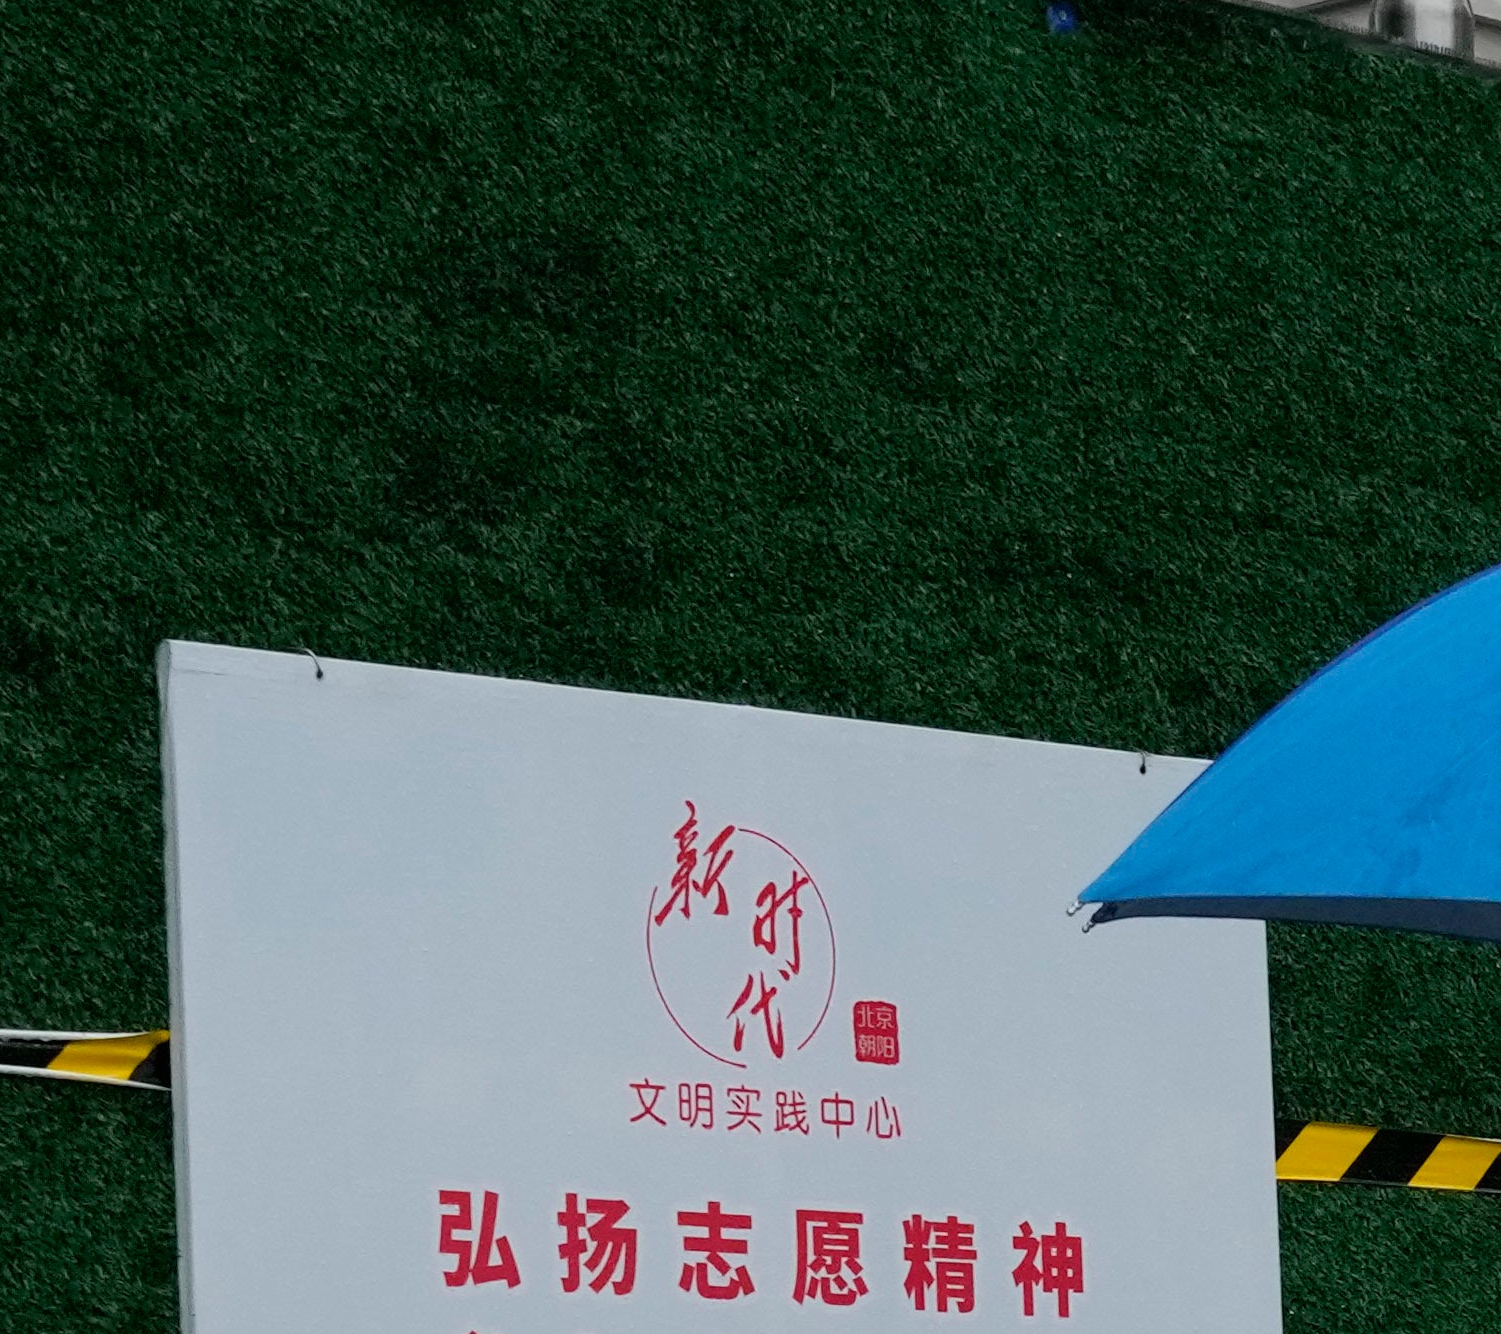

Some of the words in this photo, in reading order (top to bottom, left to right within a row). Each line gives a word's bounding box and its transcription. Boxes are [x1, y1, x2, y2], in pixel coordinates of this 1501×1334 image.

[856, 1004, 896, 1030] 北京
[629, 1078, 902, 1140] 文明实践中心
[436, 1188, 1086, 1318] 弘扬志愿精神
